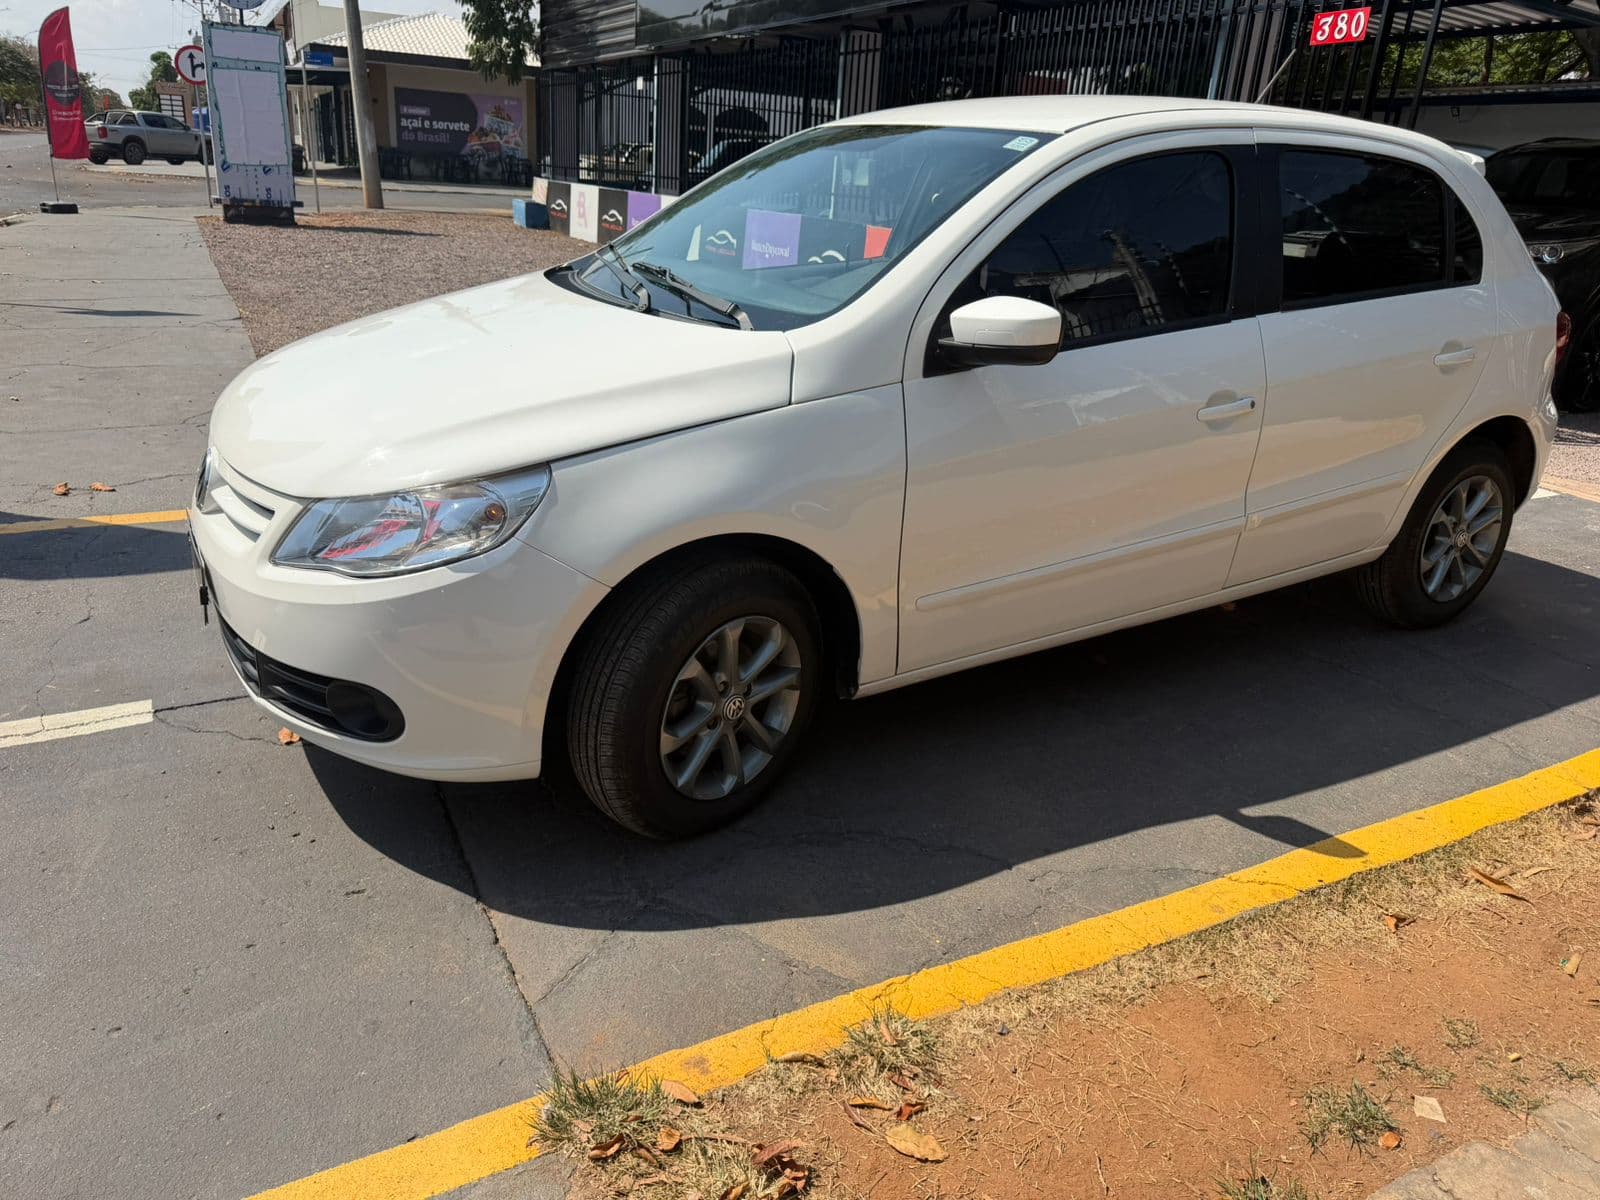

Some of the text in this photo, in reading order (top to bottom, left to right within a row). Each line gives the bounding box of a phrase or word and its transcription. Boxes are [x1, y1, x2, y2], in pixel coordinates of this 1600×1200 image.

[1316, 11, 1366, 41] 380
[400, 116, 470, 132] açaí e sorvete
[401, 130, 450, 144] do Brasil!
